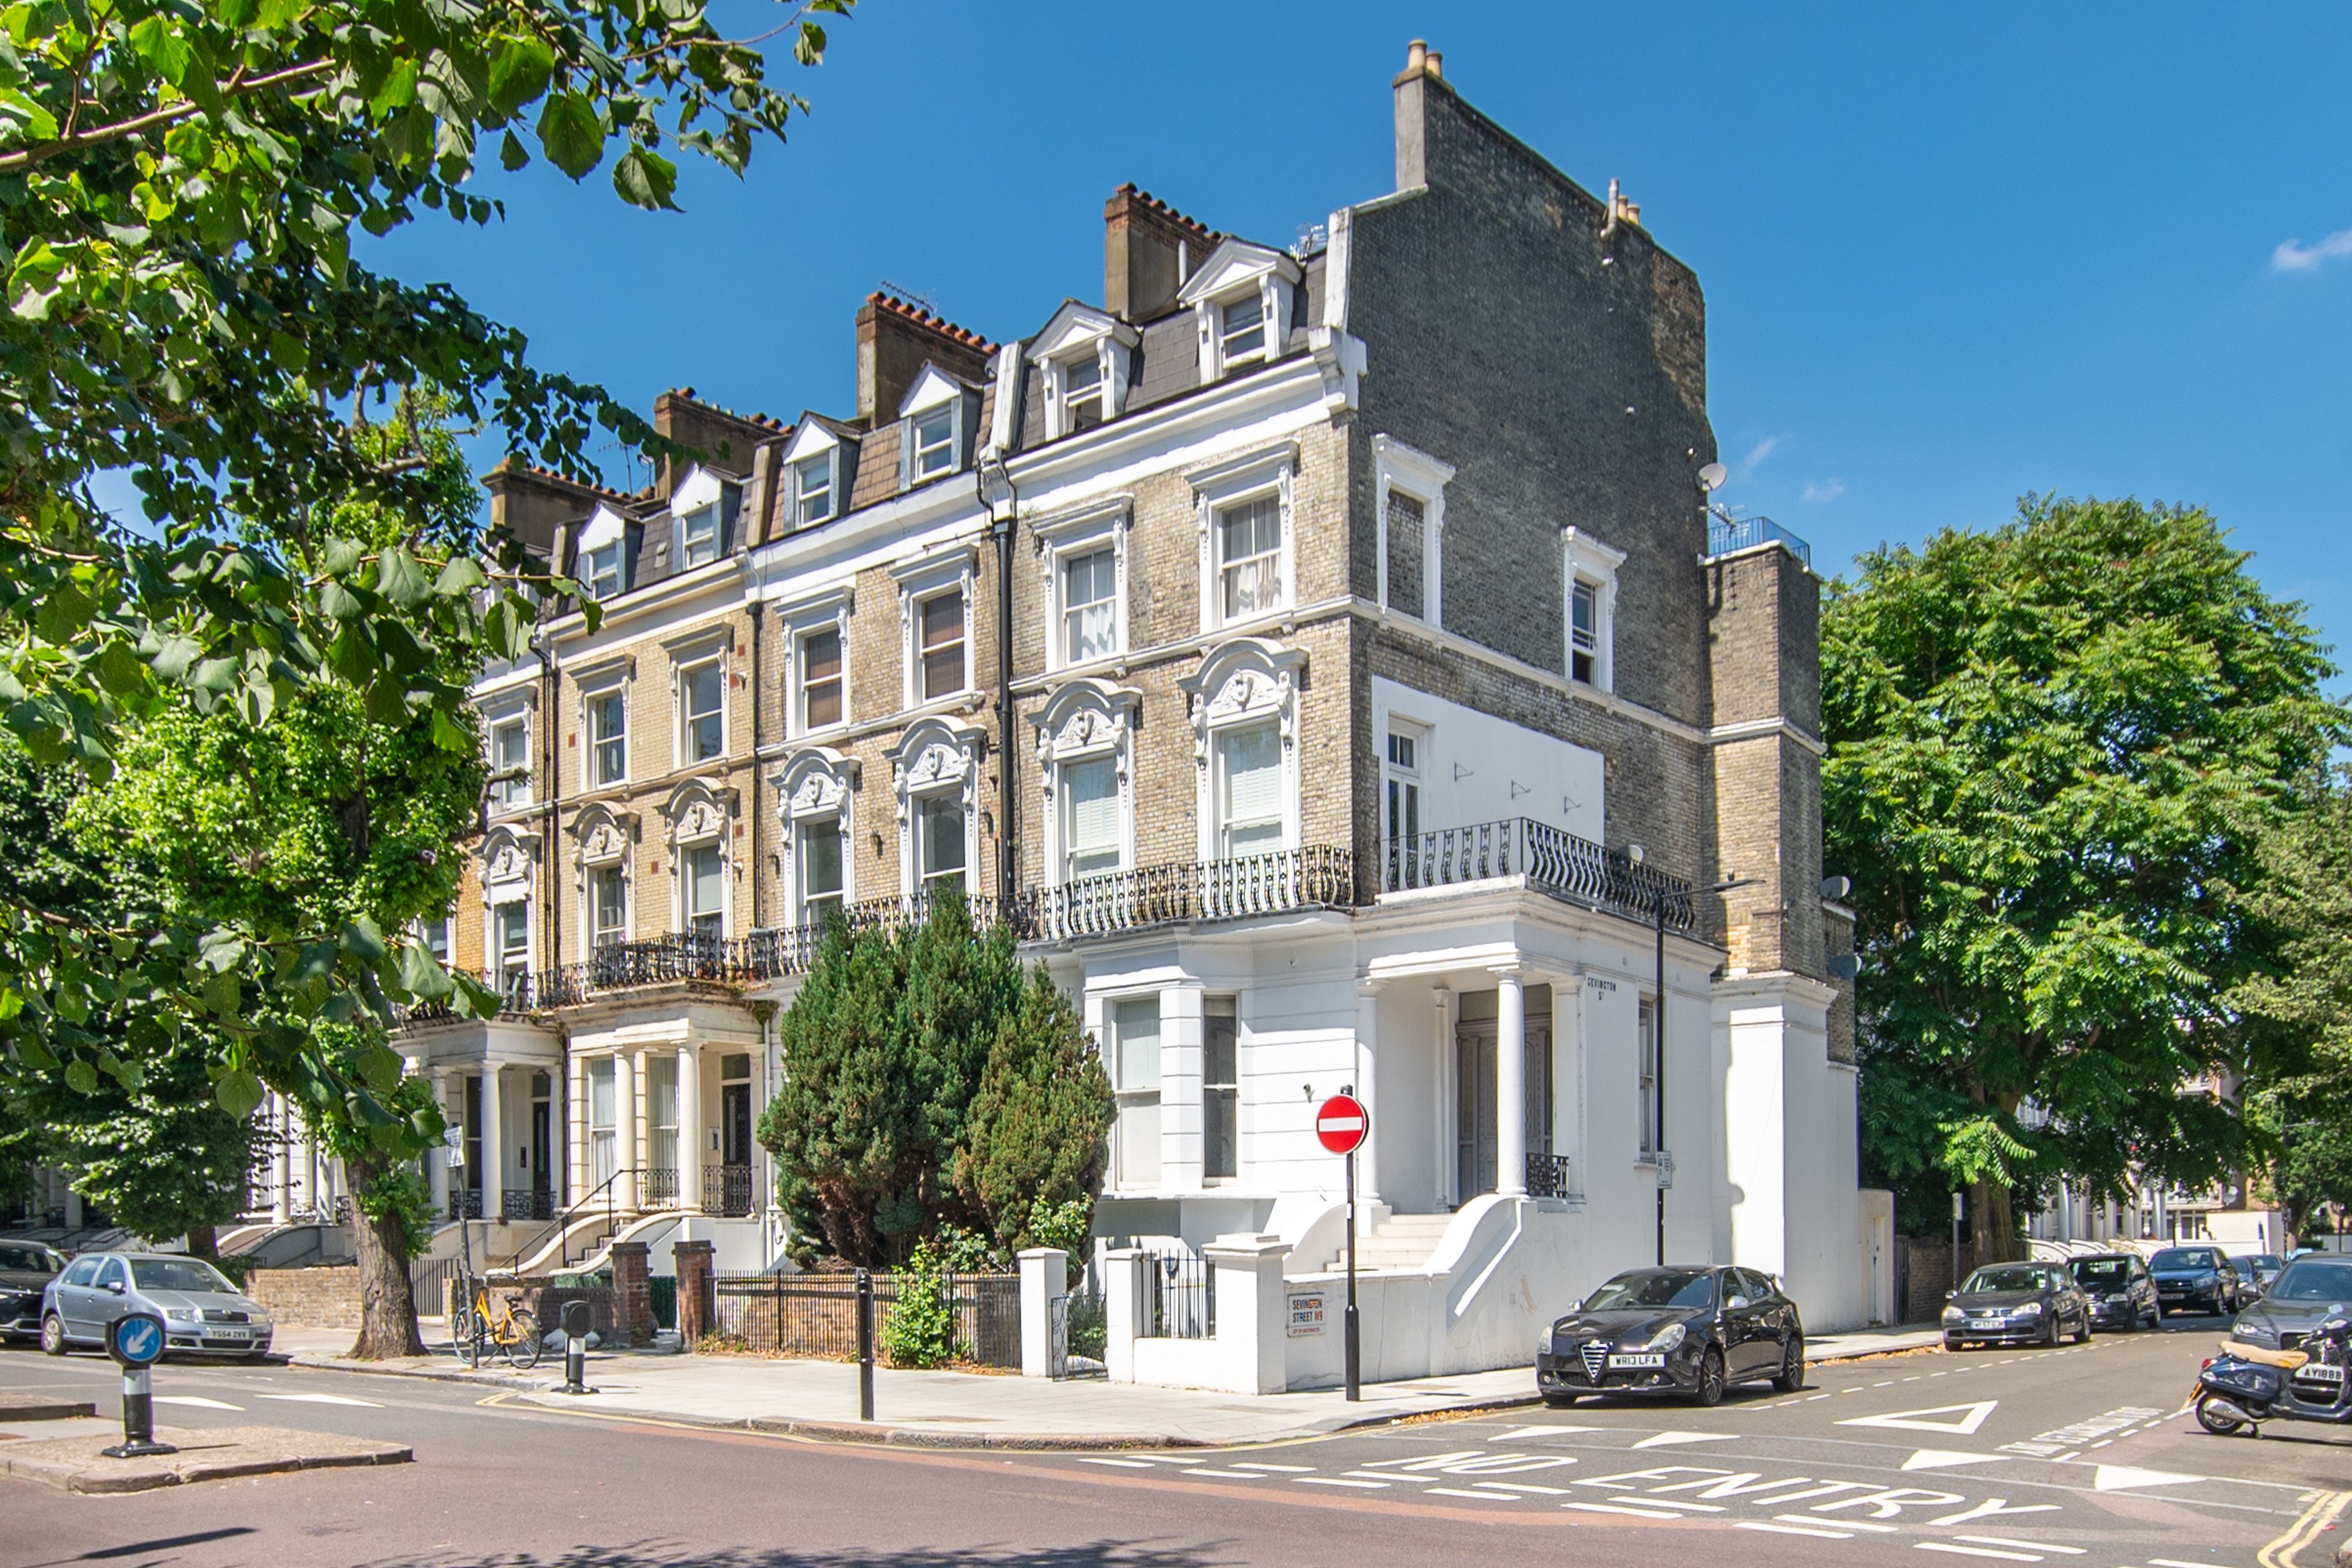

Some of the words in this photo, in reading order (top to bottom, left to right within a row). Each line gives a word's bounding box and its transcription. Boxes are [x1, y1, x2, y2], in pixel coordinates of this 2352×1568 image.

[1292, 1311, 1313, 1323] STREET
[1638, 1356, 1657, 1365] LFA
[1361, 1450, 1578, 1475] NO
[1570, 1466, 2063, 1526] ENTRY
